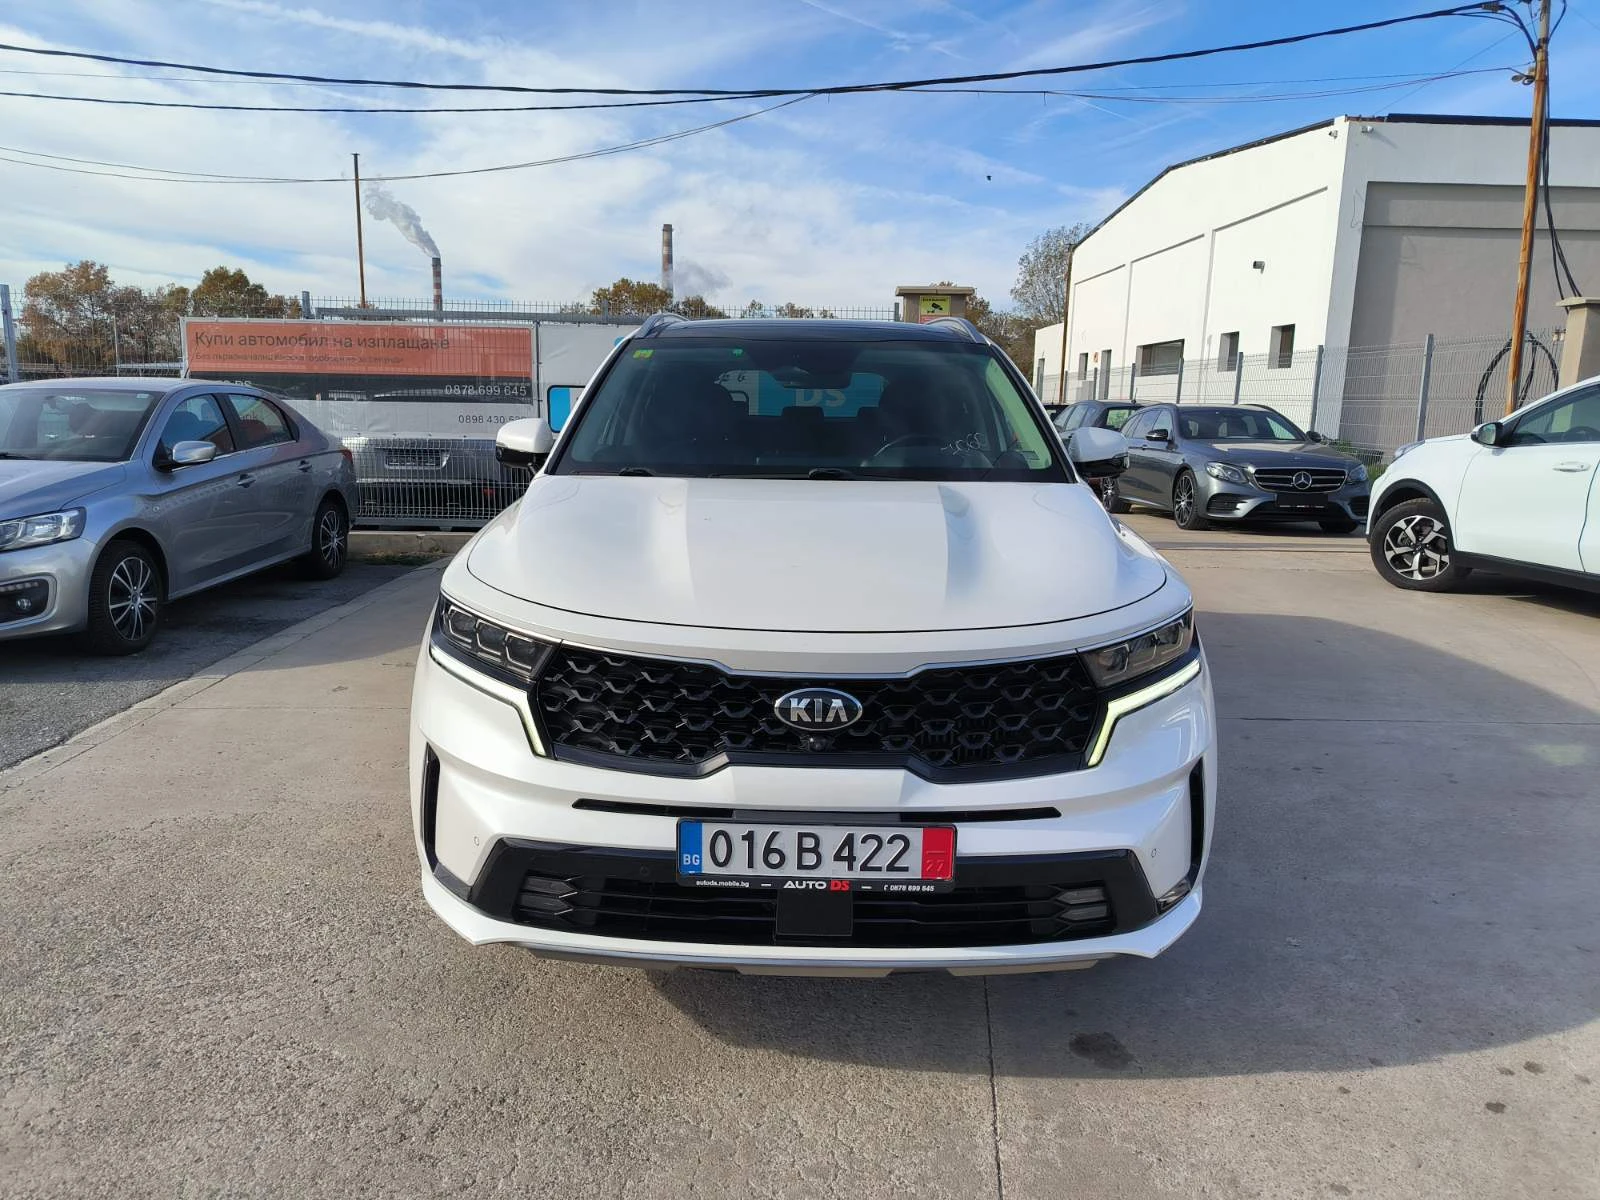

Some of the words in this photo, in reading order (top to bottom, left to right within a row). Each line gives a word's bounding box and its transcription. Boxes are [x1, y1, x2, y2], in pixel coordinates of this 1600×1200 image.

[195, 331, 234, 348] Купи
[238, 333, 328, 347] автомобил
[333, 336, 353, 348] на
[357, 336, 450, 352] изплащане
[445, 384, 475, 395] 0878
[478, 385, 501, 396] 699
[503, 385, 527, 397] 645
[458, 414, 484, 424] 0898
[486, 415, 506, 424] 430
[790, 697, 848, 722] KIA
[683, 853, 700, 866] BG
[783, 880, 827, 890] AUTO
[829, 880, 850, 891] DS
